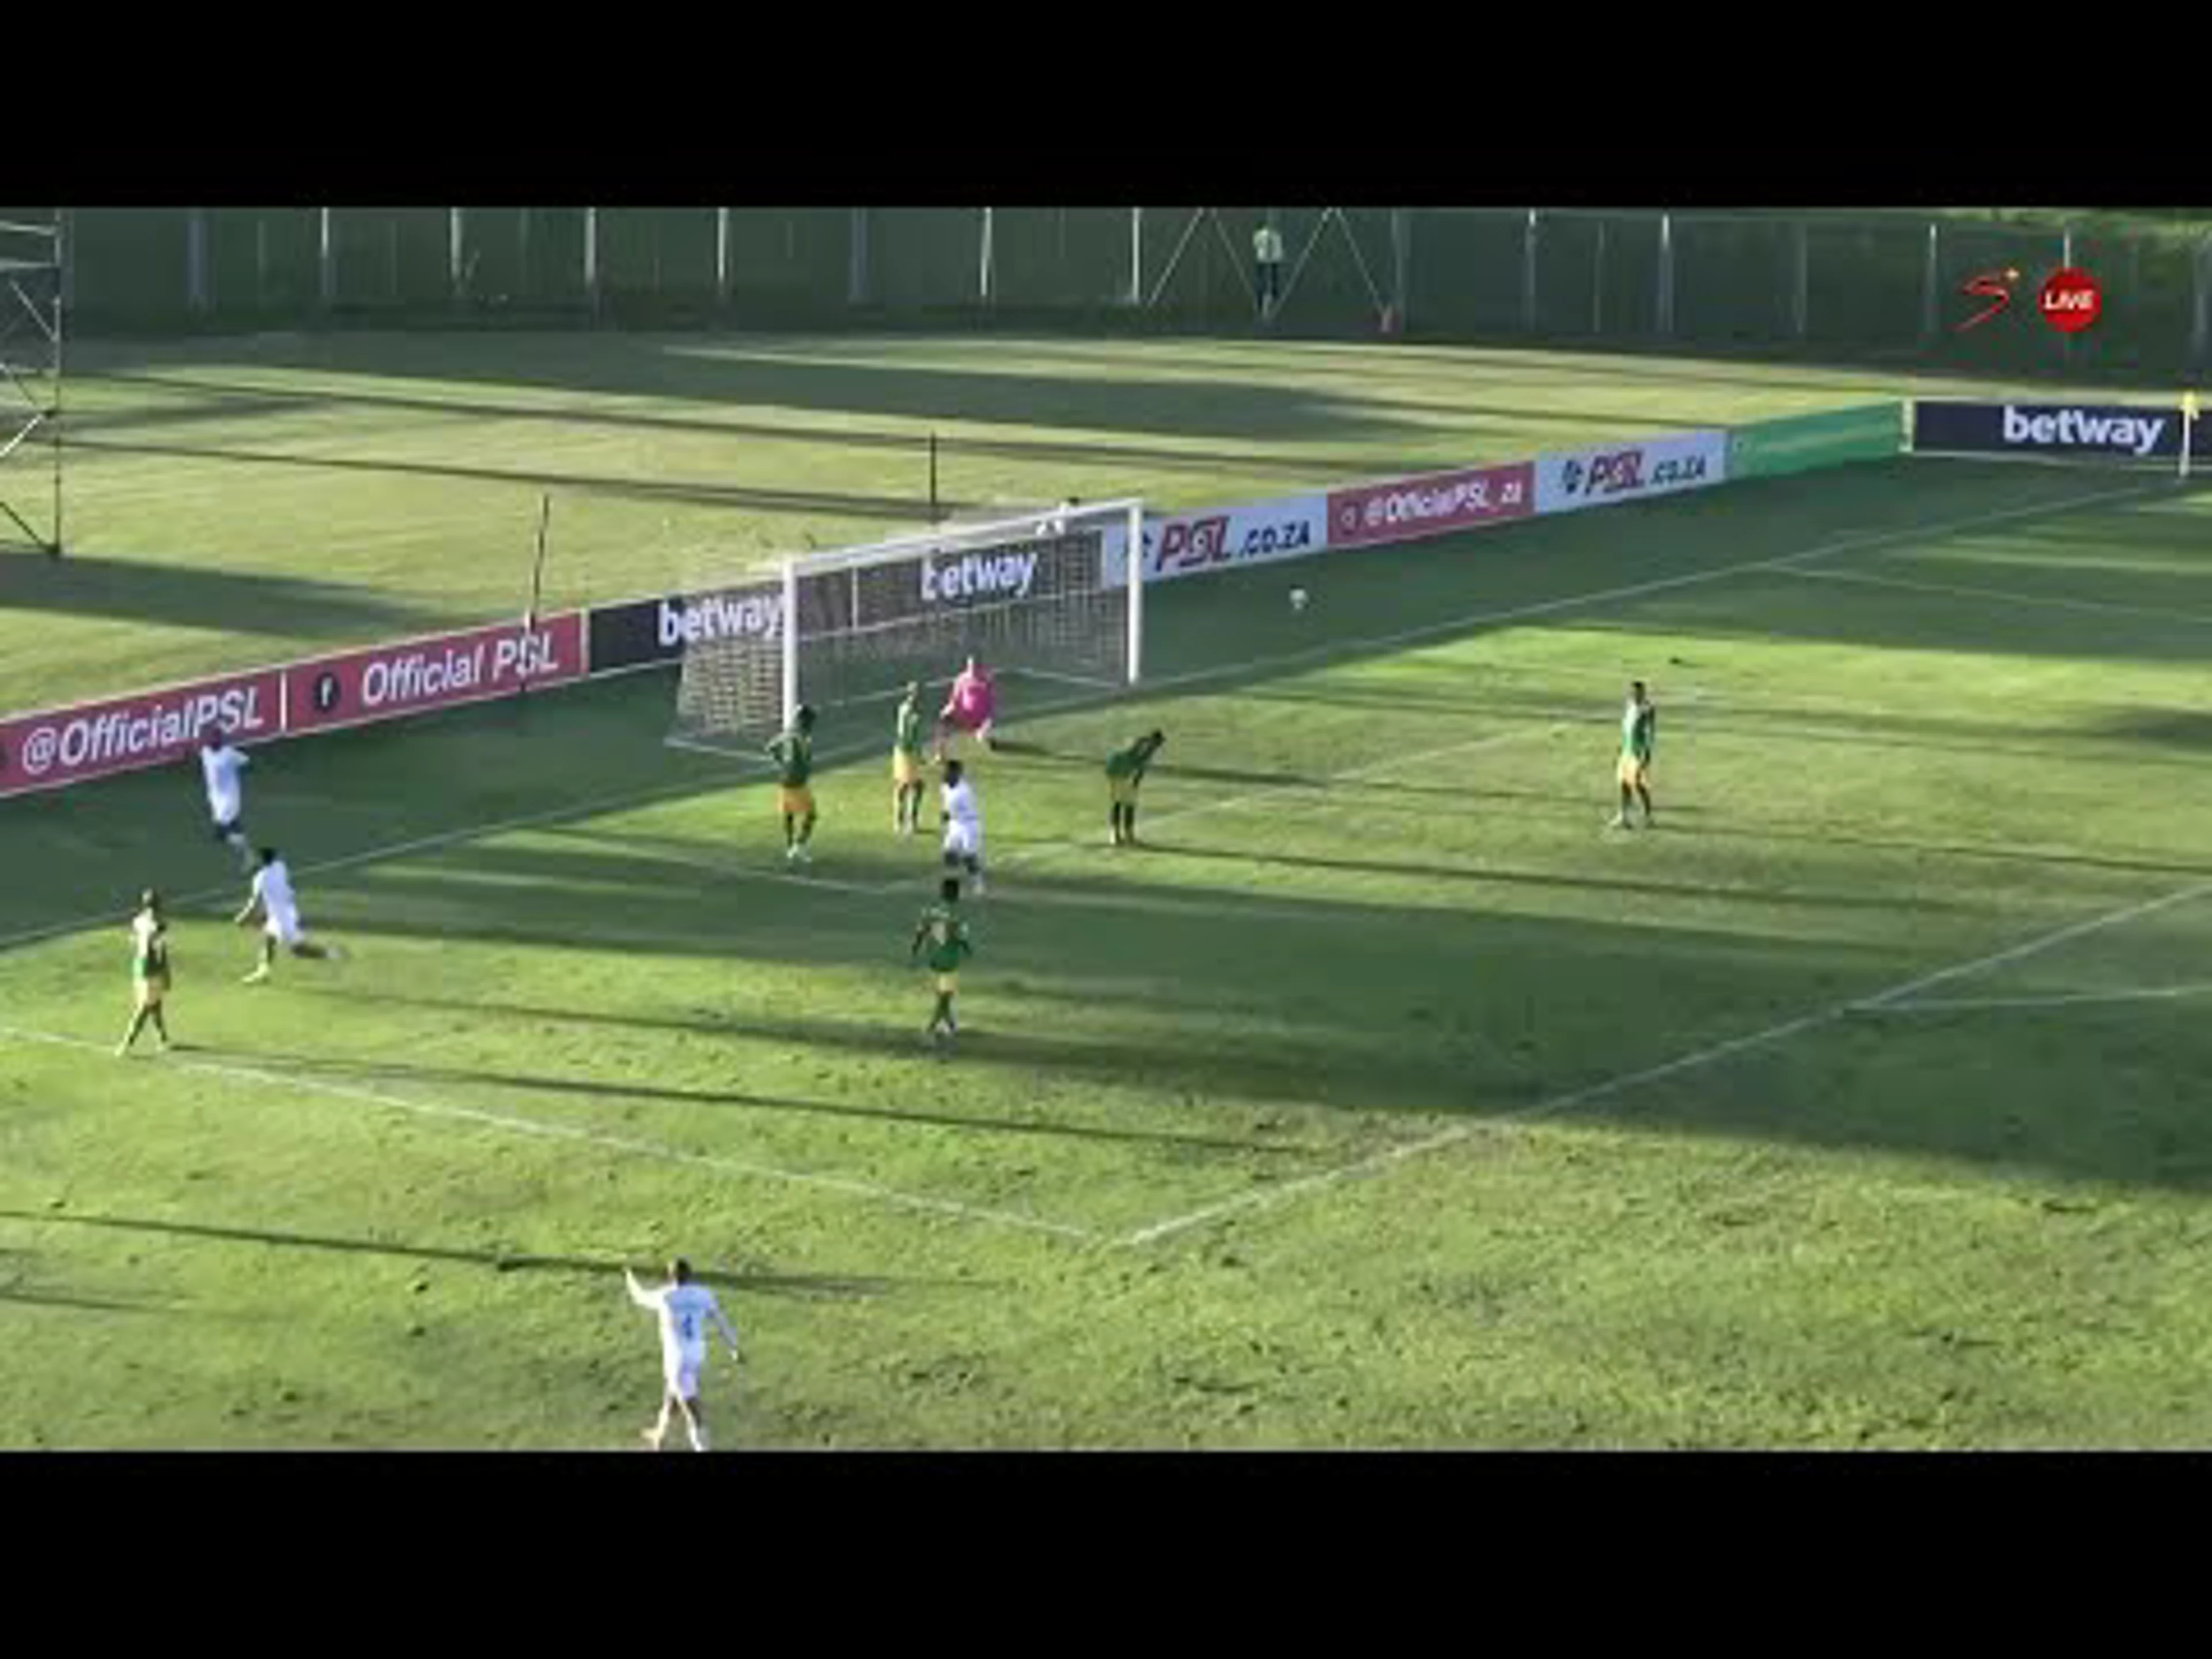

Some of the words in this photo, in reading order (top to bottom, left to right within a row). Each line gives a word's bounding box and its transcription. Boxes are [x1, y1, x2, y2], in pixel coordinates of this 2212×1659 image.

[2002, 404, 2165, 454] betway
[921, 548, 1038, 601] betway
[658, 594, 786, 646] betway
[363, 643, 485, 706] Official
[22, 687, 264, 775] @OfficialPSL
